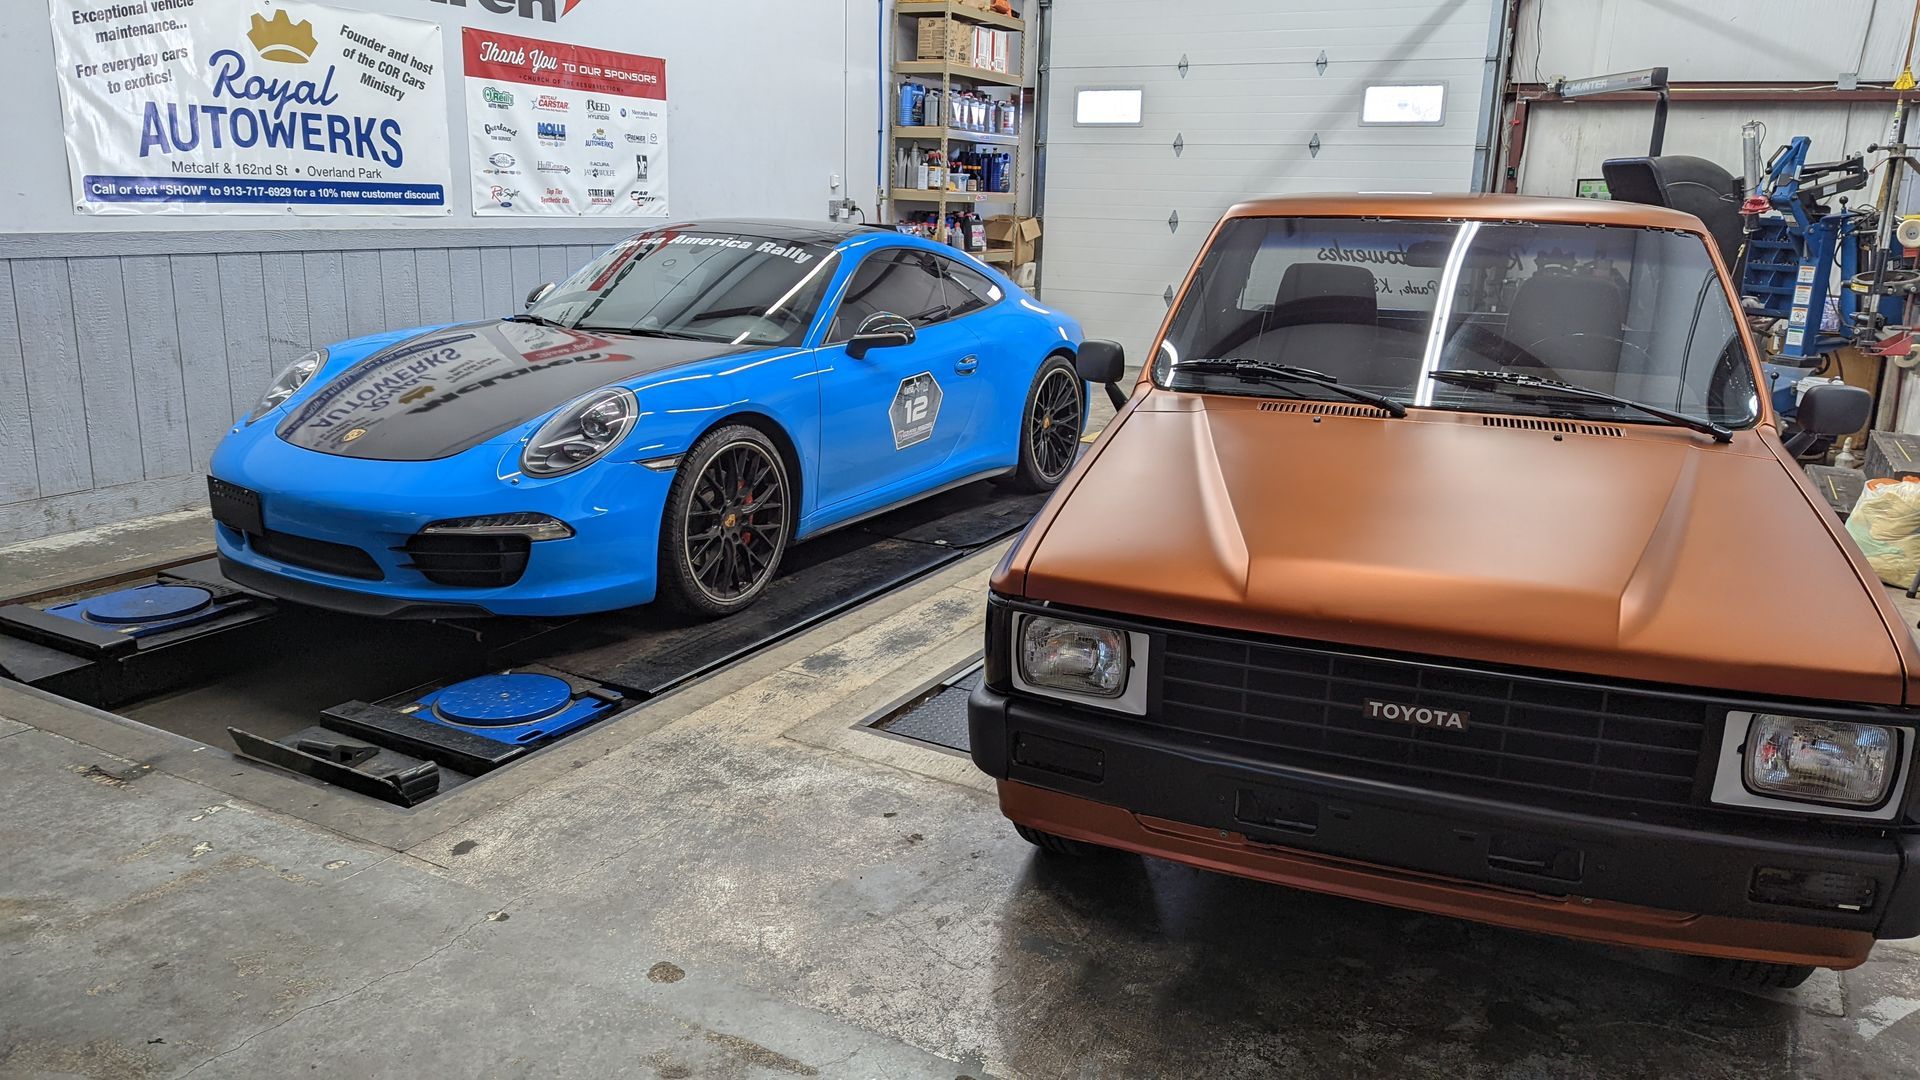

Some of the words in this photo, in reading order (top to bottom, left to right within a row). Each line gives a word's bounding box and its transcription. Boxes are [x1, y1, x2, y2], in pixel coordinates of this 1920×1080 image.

[72, 1, 148, 25] Exceptional
[95, 18, 188, 43] maintenance...
[339, 24, 386, 54] Founder
[387, 48, 410, 64] and
[410, 56, 434, 75] host
[75, 63, 98, 78] For
[102, 53, 158, 74] everyday
[162, 47, 188, 62] cars
[342, 48, 357, 60] of
[357, 52, 376, 69] the
[377, 61, 401, 79] COR
[402, 71, 426, 91] Cars
[479, 41, 526, 66] Thank
[529, 50, 558, 74] You
[562, 62, 577, 73] TO
[579, 65, 602, 77] OUR
[604, 69, 657, 84] SPONSORS
[107, 81, 121, 94] to
[124, 69, 173, 91] exotics!
[209, 49, 339, 120] Royal
[360, 72, 406, 102] Ministry
[522, 74, 550, 83] CHURCH
[1571, 80, 1608, 92] HUNTER
[538, 99, 569, 110] CARSTAR
[586, 99, 611, 112] REED
[139, 101, 404, 169] AUTOWERKS
[484, 123, 518, 137] Overland
[585, 139, 614, 150] AUTOWERKS
[171, 160, 220, 173] Metcalf
[223, 162, 232, 174] &
[235, 163, 273, 176] 162nd
[276, 165, 288, 176] St
[307, 165, 356, 178] Overland
[359, 168, 383, 179] Park
[91, 183, 116, 195] Call
[119, 186, 132, 195] or
[135, 185, 158, 196] text
[209, 187, 221, 196] to
[223, 186, 292, 197] 913-717-6929
[293, 187, 307, 197] for
[309, 189, 316, 198] a
[318, 188, 339, 199] 10%
[340, 190, 360, 199] new
[361, 190, 402, 200] customer
[404, 190, 441, 200] discount
[587, 189, 603, 197] STATE
[603, 189, 615, 198] LINE
[668, 234, 753, 250] America
[756, 241, 815, 264] Rally
[904, 395, 928, 425] 12
[1369, 701, 1463, 729] TOYOTA
